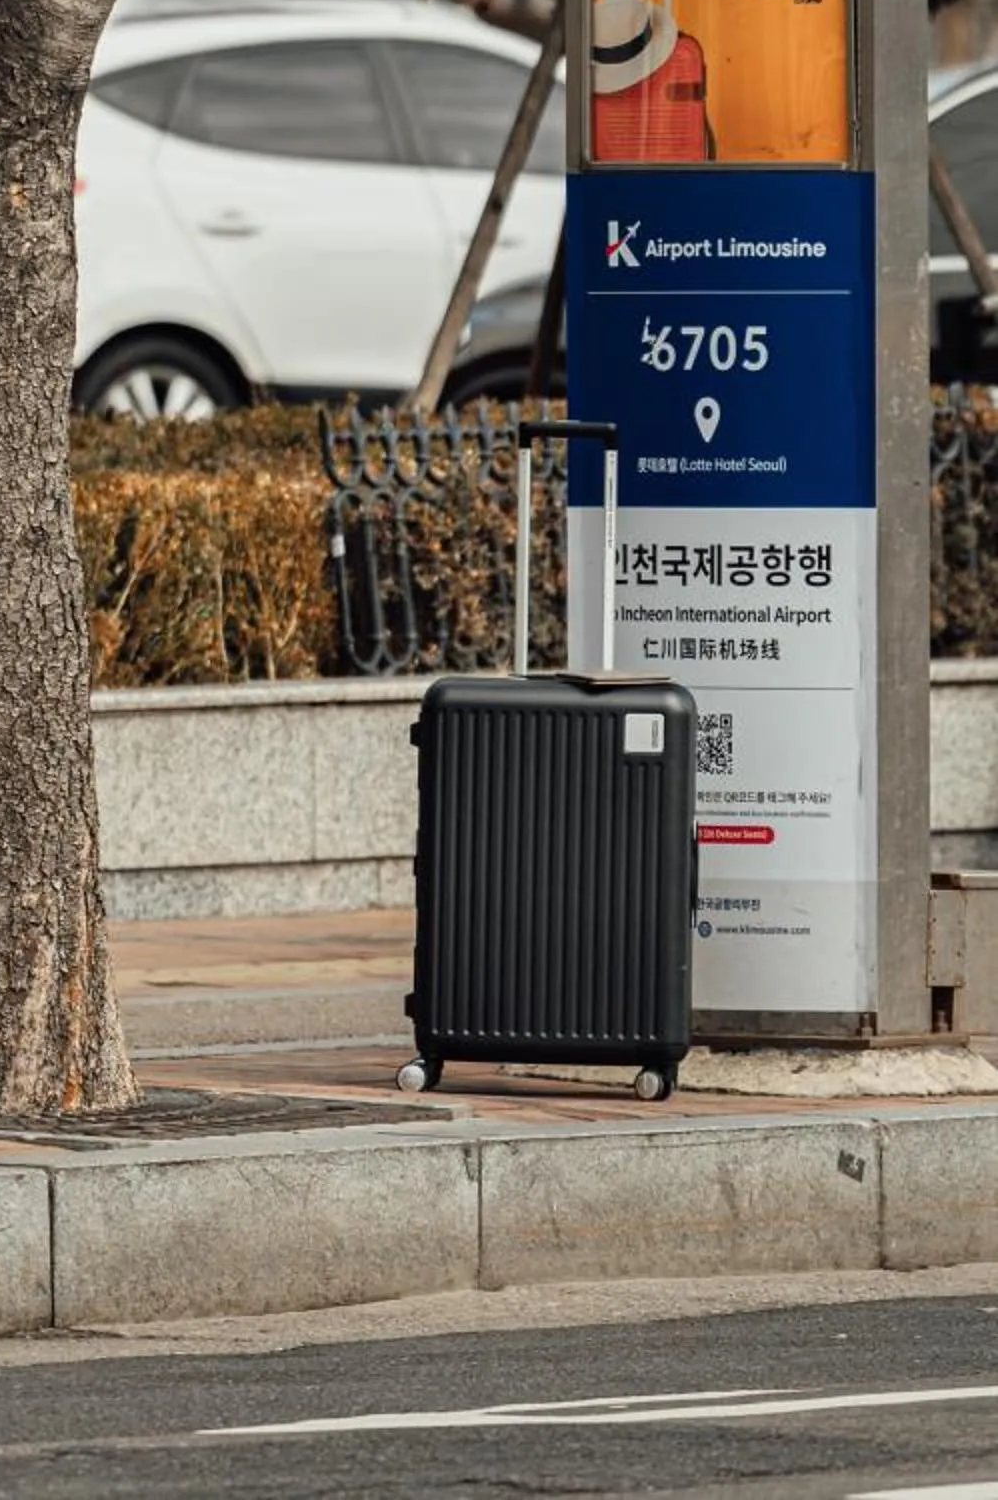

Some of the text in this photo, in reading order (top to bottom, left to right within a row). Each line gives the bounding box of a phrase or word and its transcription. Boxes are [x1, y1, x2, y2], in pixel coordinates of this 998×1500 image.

[645, 237, 713, 261] Airport
[717, 237, 827, 258] Limousine
[652, 325, 769, 372] 6705
[680, 456, 713, 475] (Lotte
[715, 457, 747, 472] Hotel
[748, 455, 787, 475] Seoul)
[621, 605, 673, 622] Incheon
[675, 606, 770, 623] International
[773, 606, 832, 626] Airport
[643, 637, 781, 661] 仁川国际机场线
